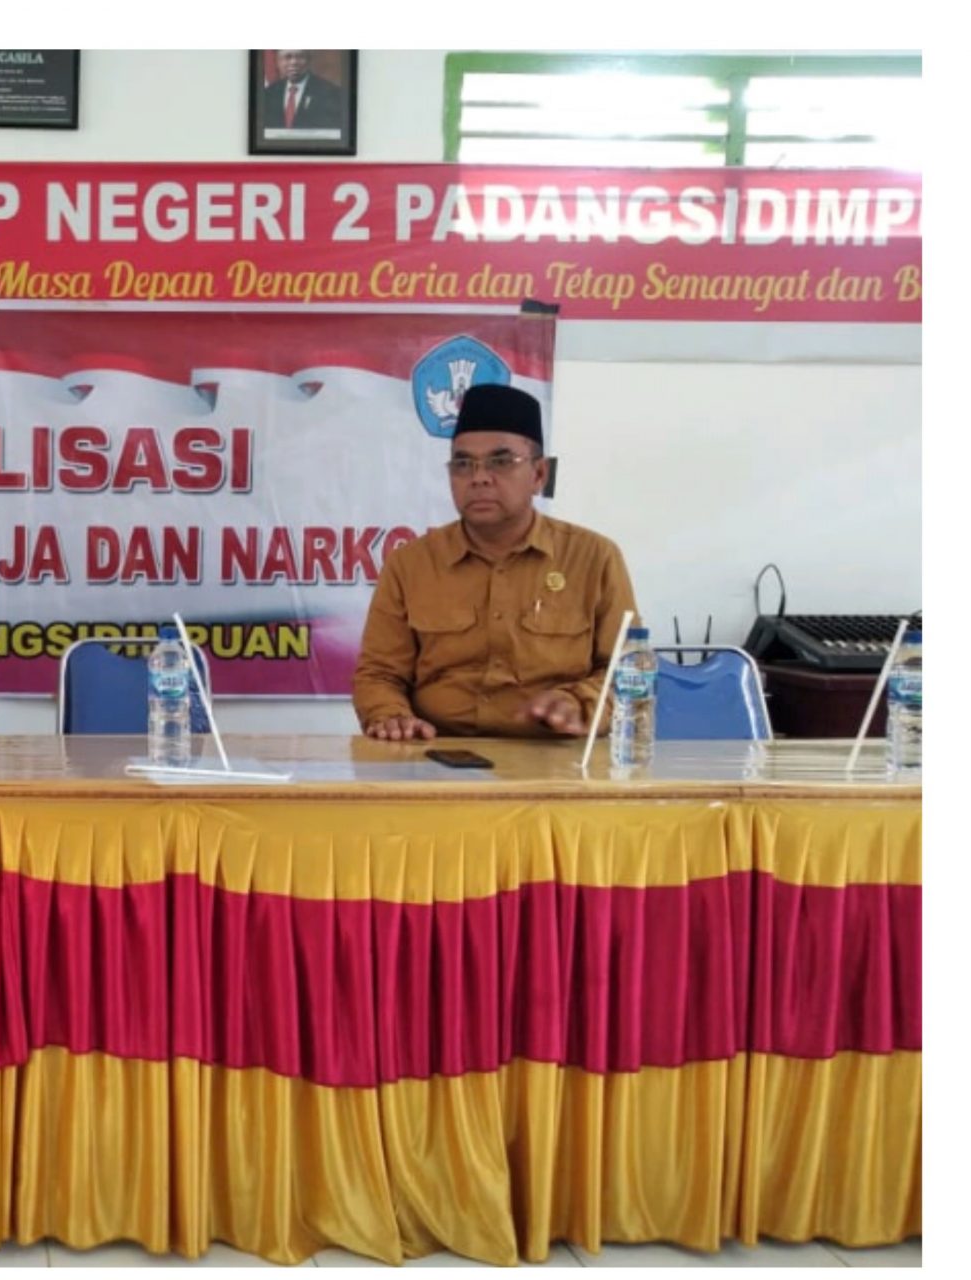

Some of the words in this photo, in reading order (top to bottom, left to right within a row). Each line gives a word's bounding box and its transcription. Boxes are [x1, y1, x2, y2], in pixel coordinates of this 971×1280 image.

[46, 182, 305, 243] NEGERI
[332, 183, 370, 241] 2
[396, 184, 922, 246] PADANGSIDIMP
[103, 261, 215, 302] Depan
[227, 261, 360, 304] Dengan
[369, 261, 457, 299] Ceria
[467, 263, 534, 300] dan
[545, 262, 635, 309] Tetap
[642, 263, 810, 313] Semangat
[815, 267, 884, 301] dan
[86, 525, 201, 584] DAN
